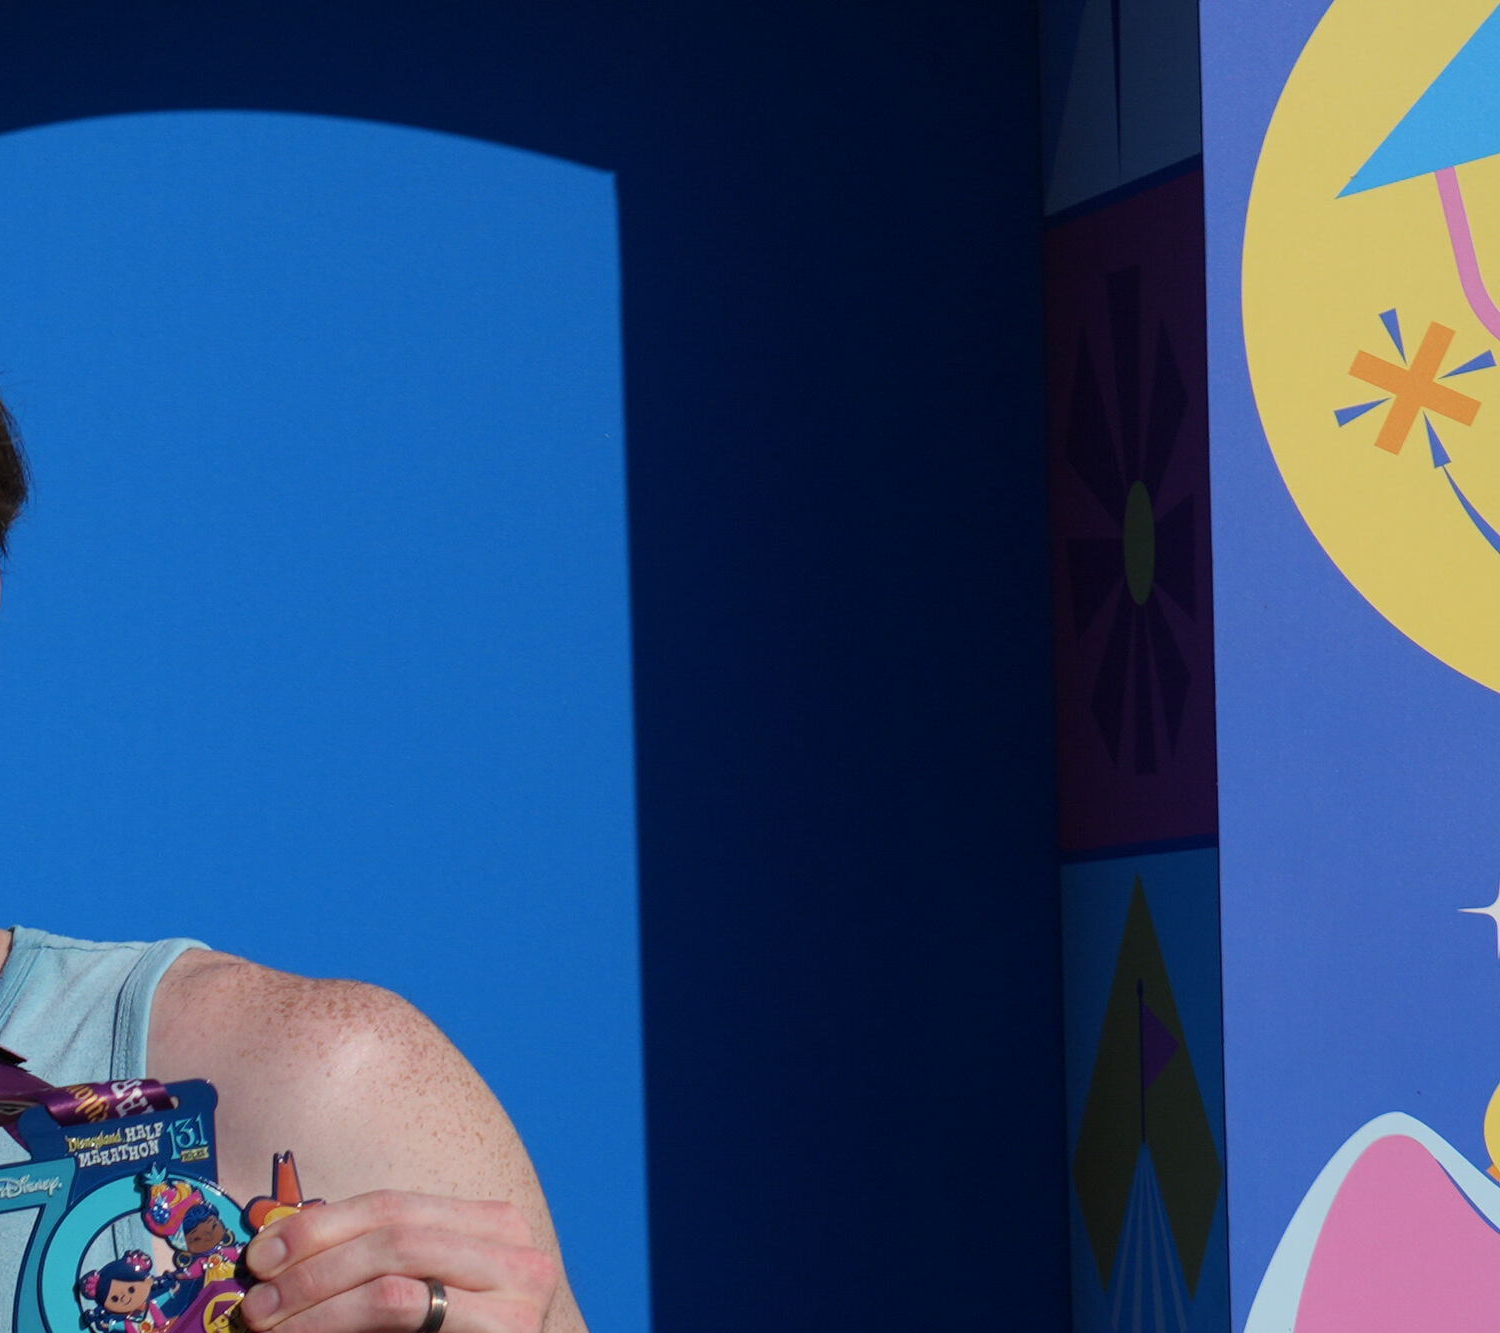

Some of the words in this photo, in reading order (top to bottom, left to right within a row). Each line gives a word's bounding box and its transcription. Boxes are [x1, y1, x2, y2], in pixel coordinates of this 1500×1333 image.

[65, 1129, 124, 1152] Disneyland
[125, 1122, 164, 1143] HALF
[167, 1113, 208, 1160] 13.1
[76, 1139, 160, 1168] MARATHON
